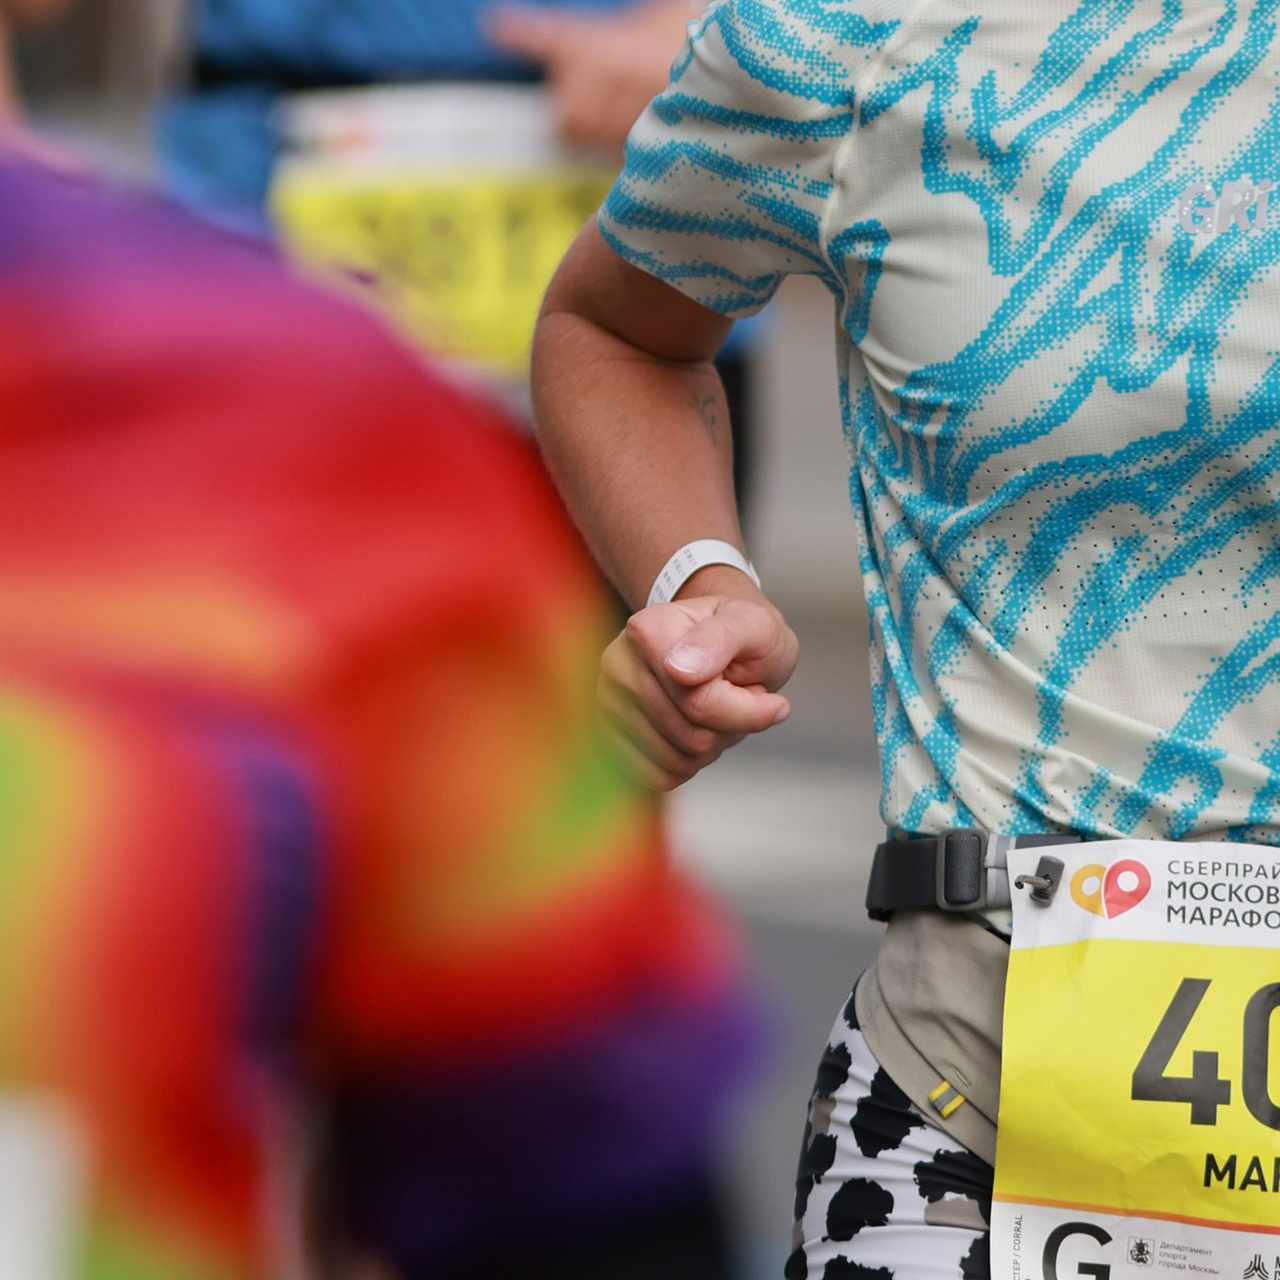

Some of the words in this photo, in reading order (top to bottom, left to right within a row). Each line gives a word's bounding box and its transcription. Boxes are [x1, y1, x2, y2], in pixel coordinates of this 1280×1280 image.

[1013, 1213, 1023, 1251] CORRAL
[1159, 1241, 1213, 1256] Департамент
[1159, 1250, 1187, 1261] спорта
[1158, 1260, 1187, 1270] города
[1188, 1263, 1220, 1275] Москвы
